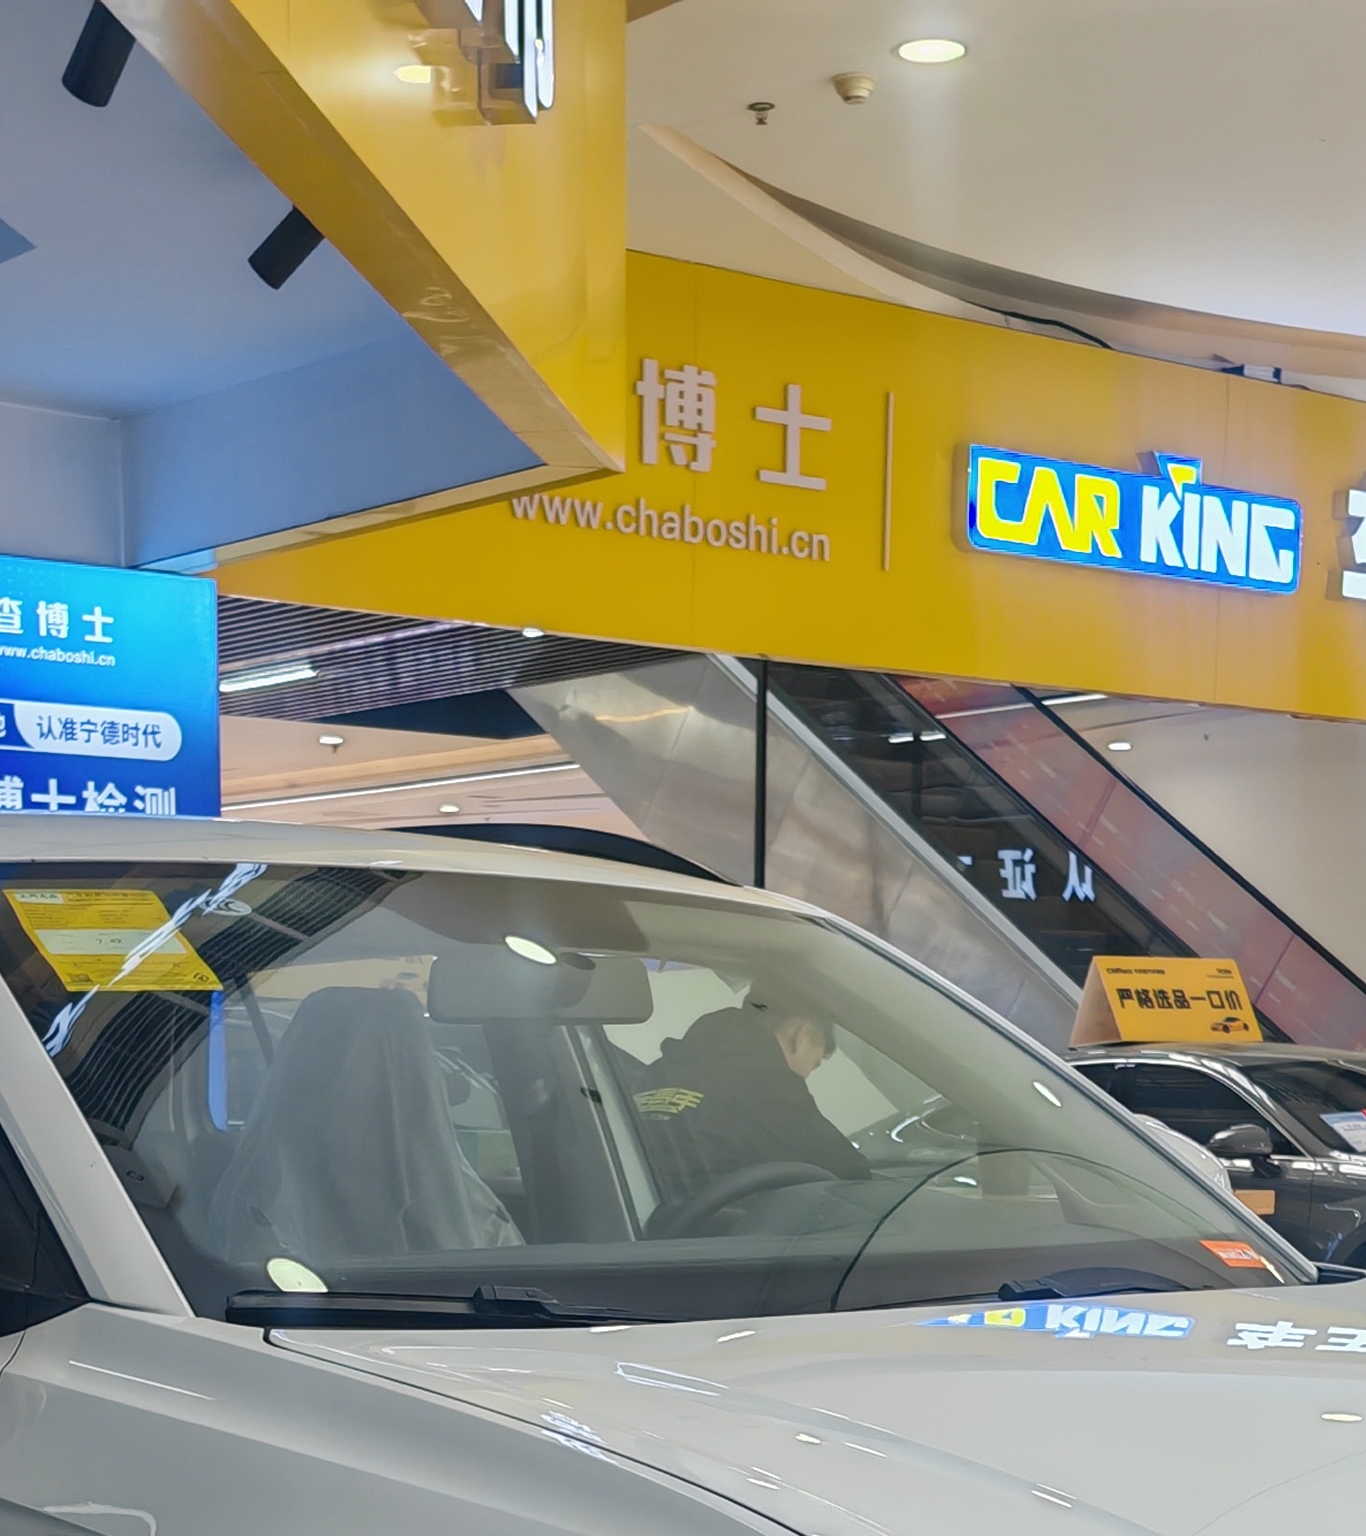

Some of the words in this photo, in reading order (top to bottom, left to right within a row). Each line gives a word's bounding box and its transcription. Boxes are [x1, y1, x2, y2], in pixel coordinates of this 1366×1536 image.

[635, 358, 832, 490] 博士
[511, 490, 831, 562] www.chaboshi.cn
[977, 457, 1122, 559] CAR
[1140, 464, 1297, 586] KING
[36, 714, 162, 750] 认准宁德时代
[1115, 987, 1244, 1011] 严格选品一口价
